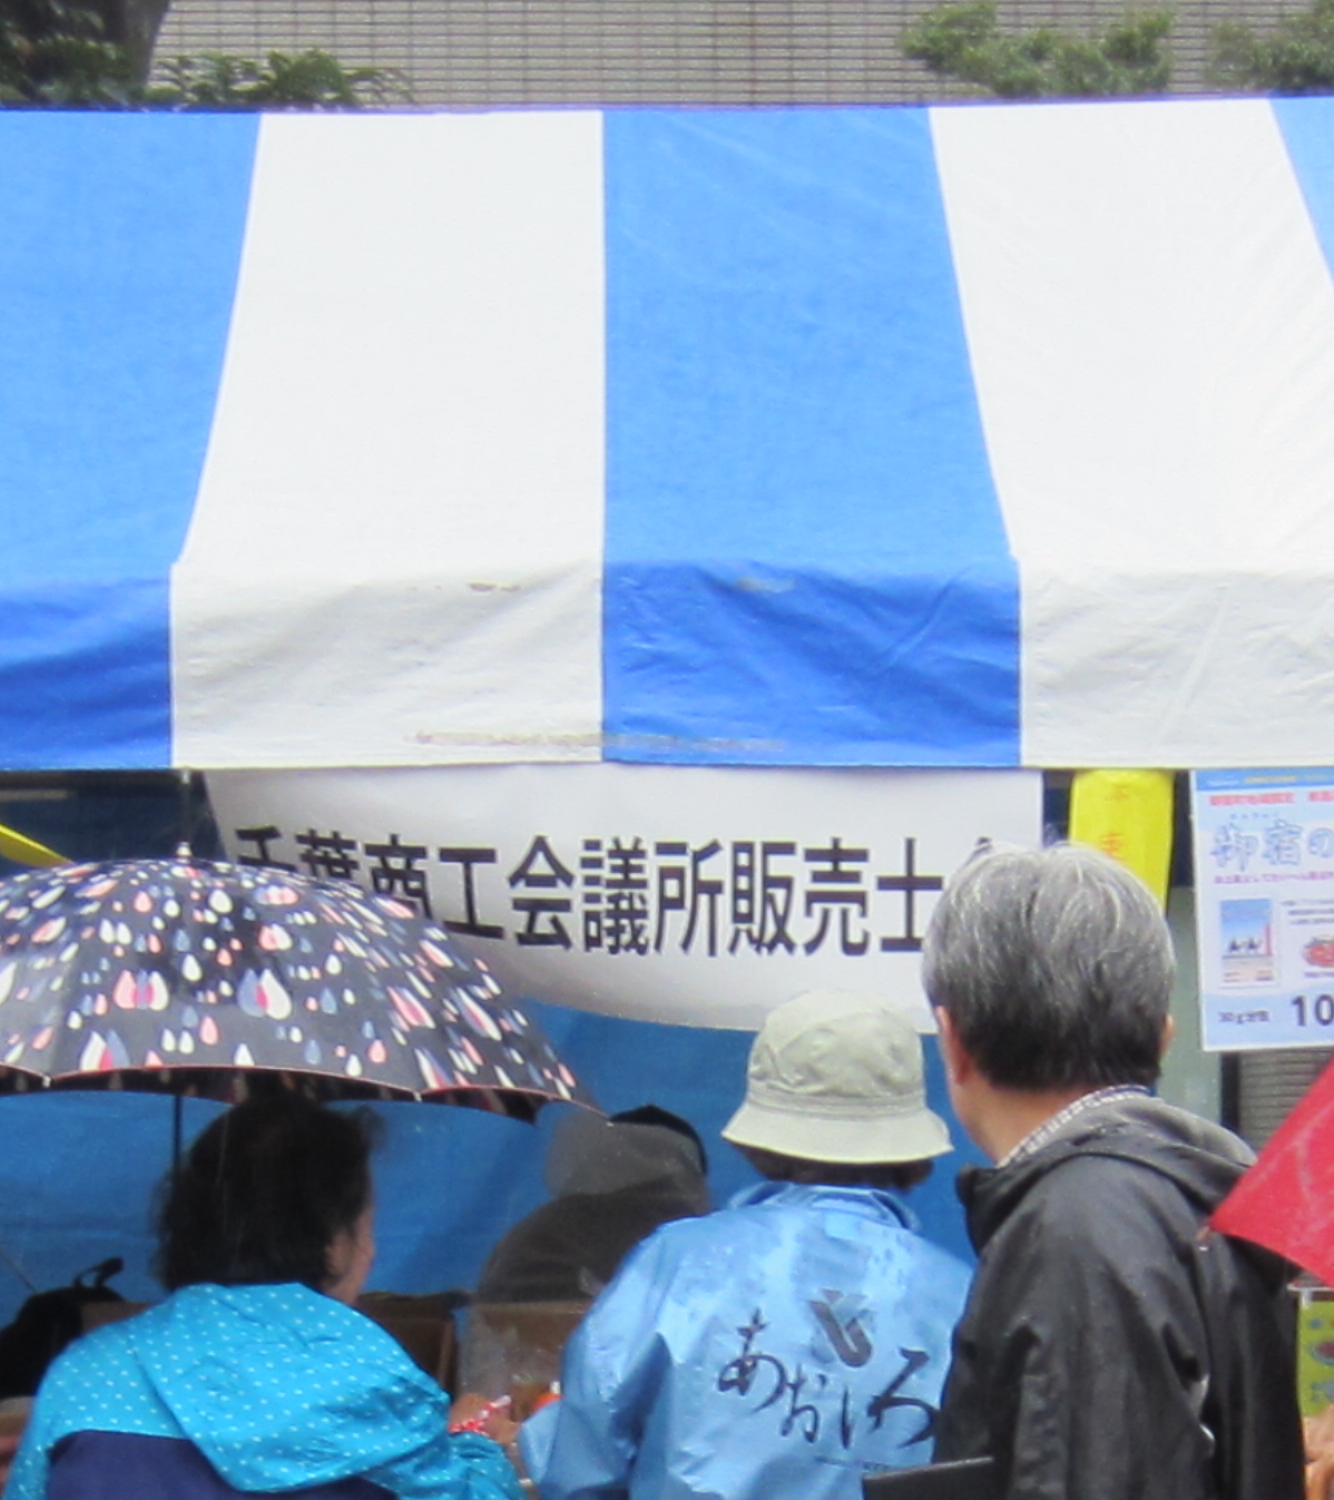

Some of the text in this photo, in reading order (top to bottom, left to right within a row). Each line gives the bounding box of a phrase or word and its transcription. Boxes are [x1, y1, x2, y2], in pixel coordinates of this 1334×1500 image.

[234, 825, 991, 958] 千葉商工会議所販売士
